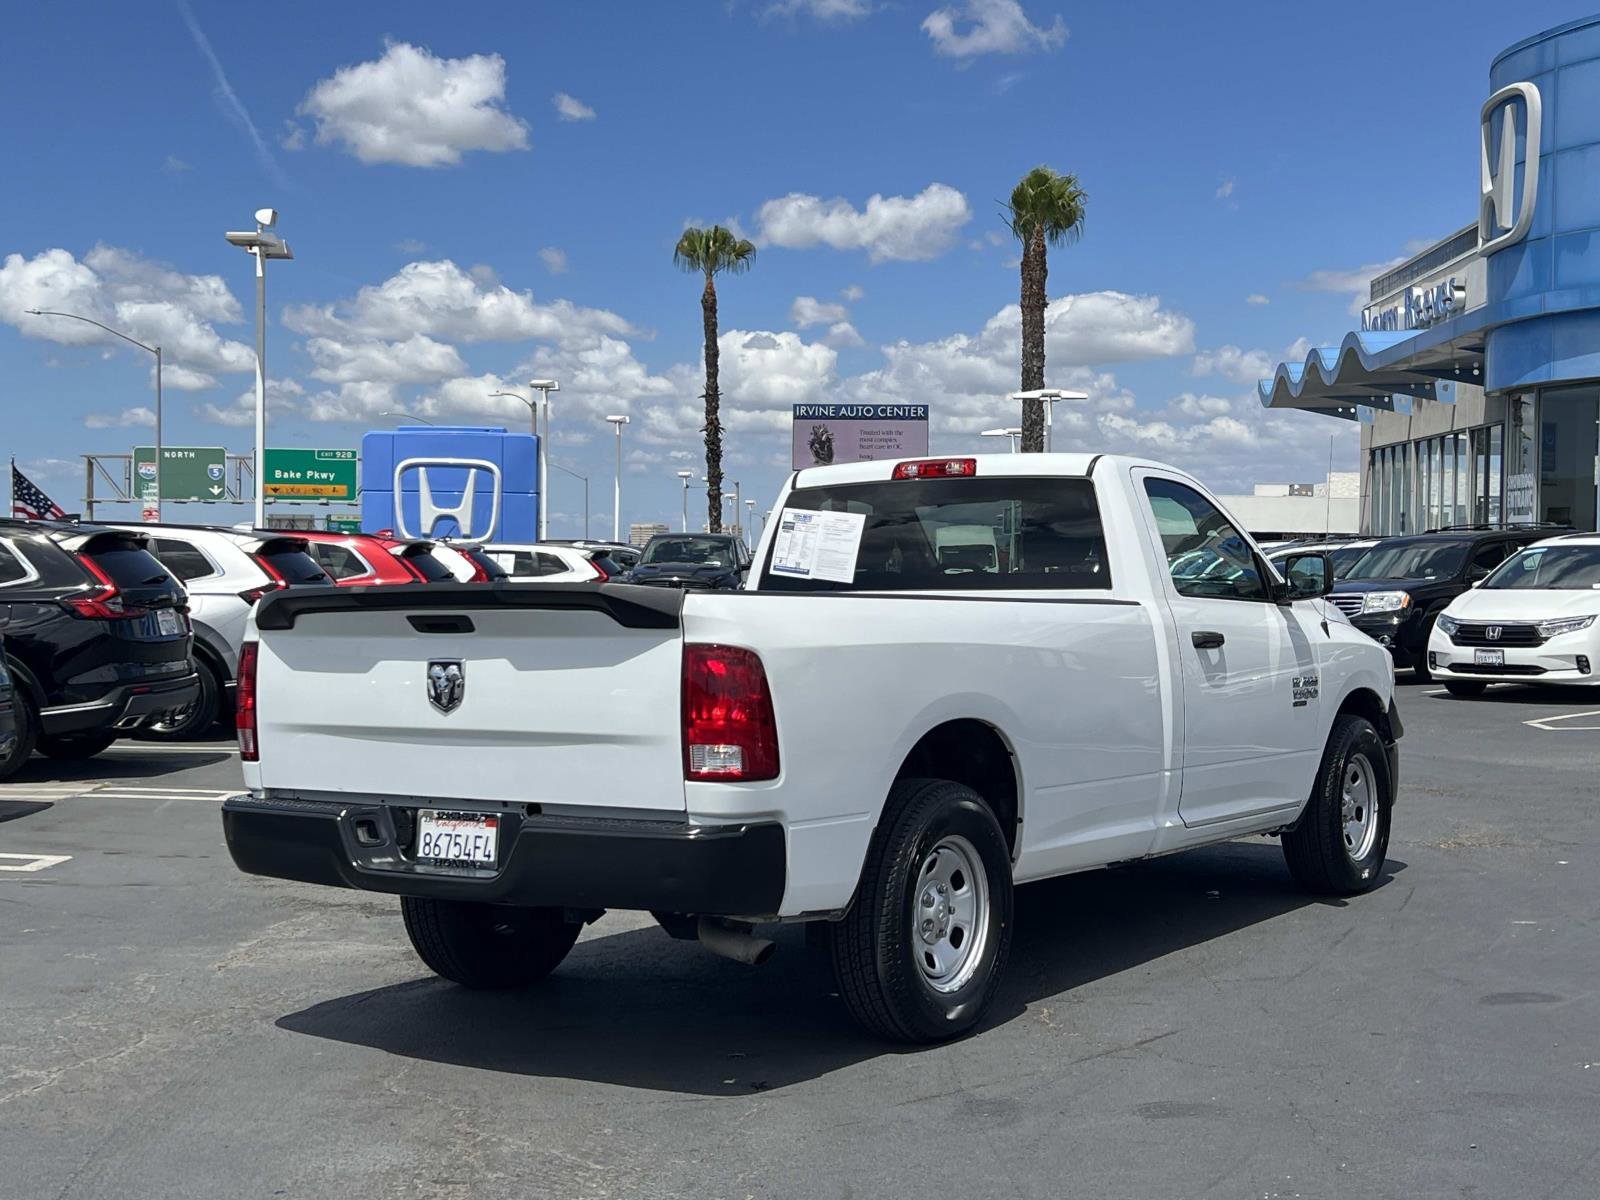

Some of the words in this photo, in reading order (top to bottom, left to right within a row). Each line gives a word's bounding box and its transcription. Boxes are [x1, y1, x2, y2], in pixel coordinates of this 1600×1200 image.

[1404, 277, 1457, 331] Reeves
[796, 406, 836, 416] IRVINE
[839, 406, 874, 417] AUTO
[877, 406, 925, 417] CENTER
[213, 468, 219, 477] 5
[274, 469, 302, 479] Bake
[306, 470, 336, 481] Pkwy
[422, 832, 492, 860] 86754F4
